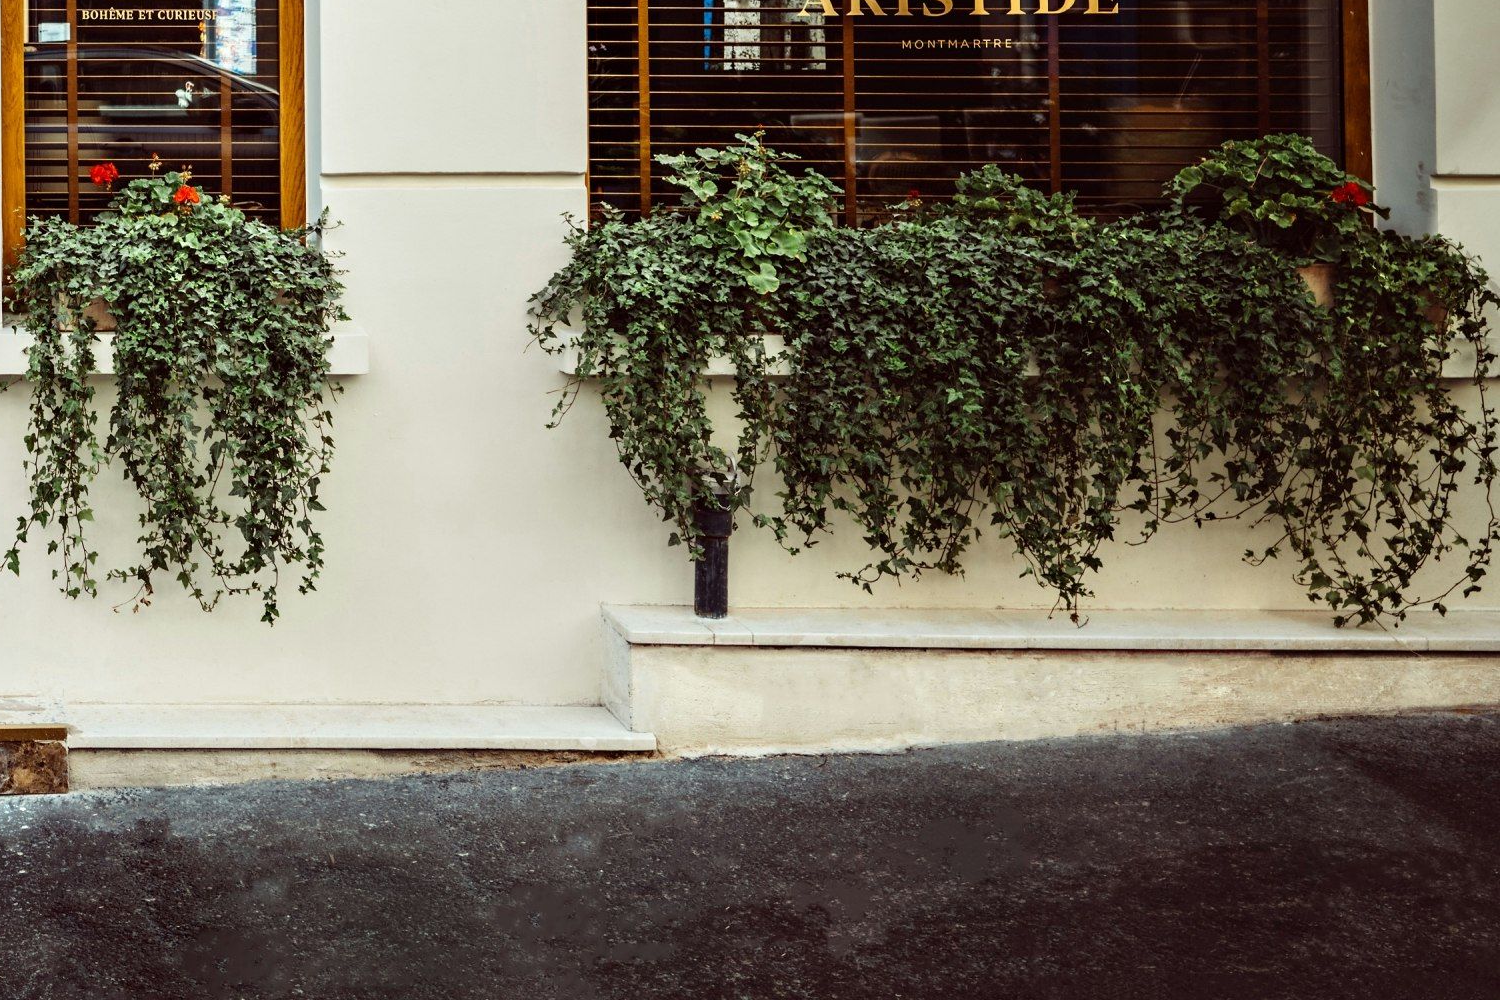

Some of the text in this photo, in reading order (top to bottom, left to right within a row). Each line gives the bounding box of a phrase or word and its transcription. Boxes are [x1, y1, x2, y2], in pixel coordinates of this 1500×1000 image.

[82, 7, 134, 20] BOHÊME
[138, 10, 154, 20] ET
[901, 38, 1013, 50] MONTMARTRE
